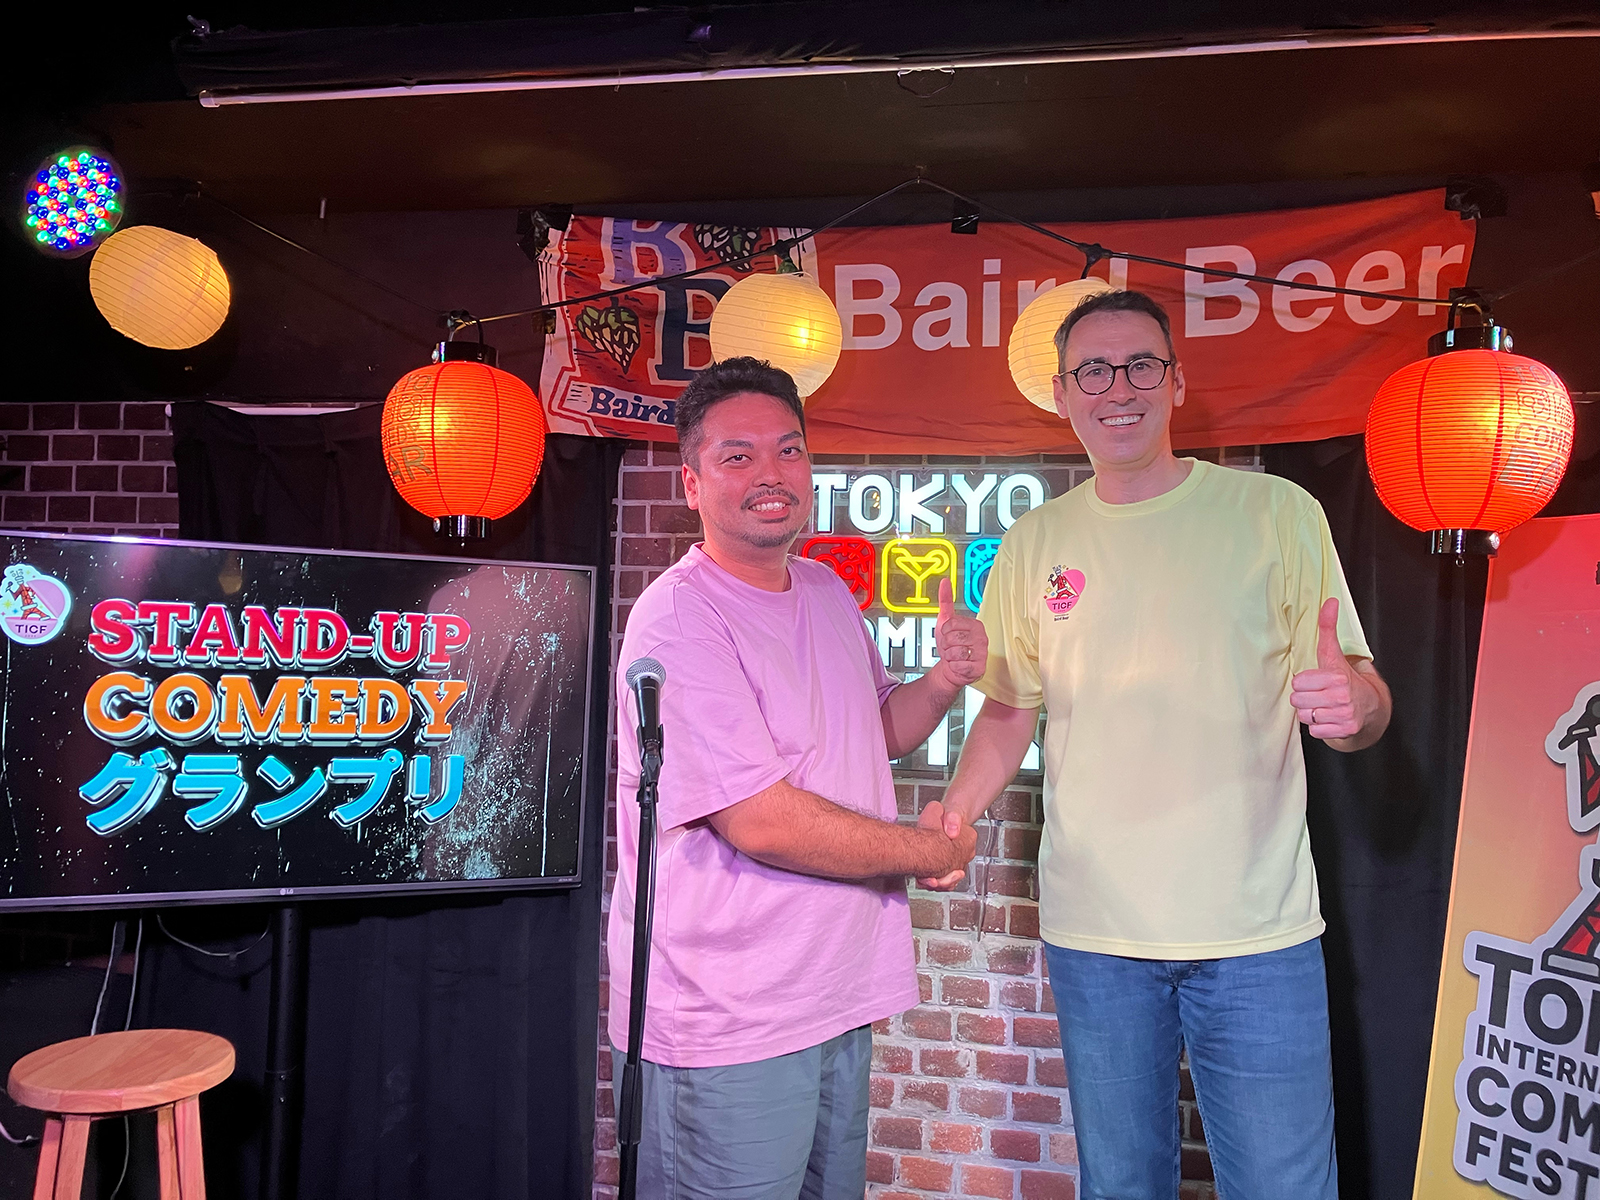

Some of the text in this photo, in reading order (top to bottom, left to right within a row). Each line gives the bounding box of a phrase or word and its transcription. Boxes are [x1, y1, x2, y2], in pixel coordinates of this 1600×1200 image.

[1185, 244, 1466, 338] Beer
[587, 386, 676, 425] Baird
[812, 472, 1046, 535] TOKYO
[15, 624, 47, 635] TICF
[88, 598, 472, 672] STAND-UP
[1052, 601, 1072, 610] TICF
[83, 671, 468, 747] COMEDY
[78, 747, 466, 836] グランプリ
[1476, 1024, 1600, 1094] INTERN
[1465, 1121, 1600, 1200] FEST
